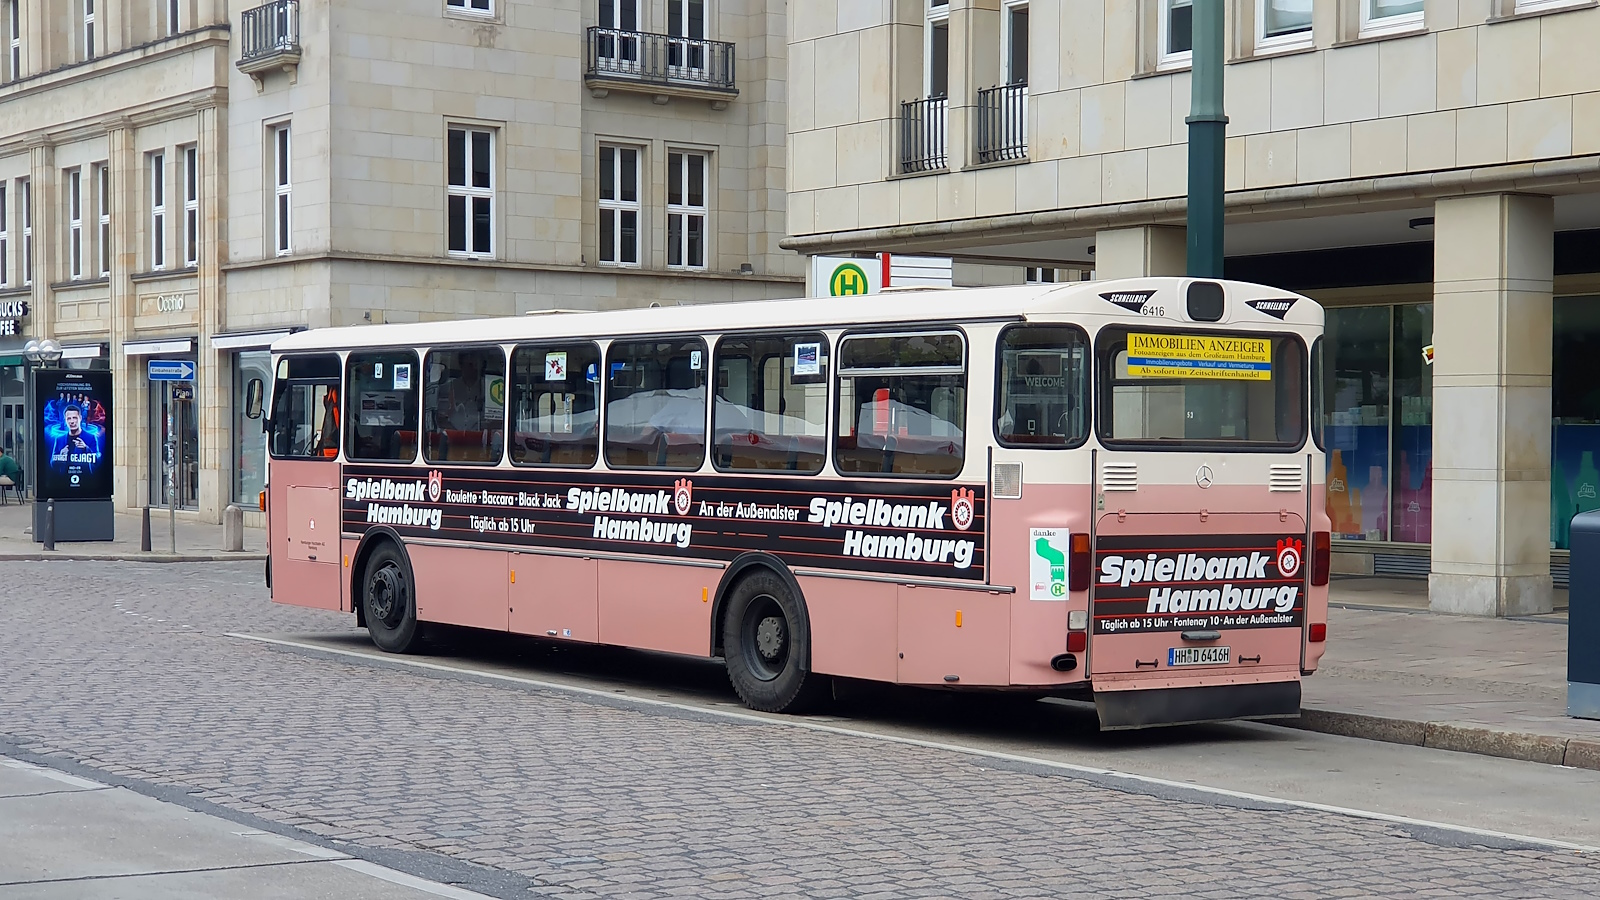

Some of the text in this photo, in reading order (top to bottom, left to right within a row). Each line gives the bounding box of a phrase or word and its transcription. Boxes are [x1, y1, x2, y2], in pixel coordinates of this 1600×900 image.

[841, 274, 858, 296] H
[157, 294, 184, 312] Occhio
[1110, 294, 1147, 303] SCHNELLBUS
[1255, 301, 1290, 311] SCHNELLBUS
[1142, 305, 1165, 317] 6416
[1133, 336, 1266, 353] IMMOBILIEN ANZEIGER
[1133, 348, 1174, 358] Fotoanzeigen
[1203, 352, 1235, 360] Großraum
[1236, 353, 1266, 362] Hamburg
[1145, 358, 1193, 367] Immobilienangebote
[1198, 360, 1216, 368] Verkauf
[1228, 362, 1255, 370] Vermietung
[1140, 366, 1152, 374] Ab
[1153, 367, 1175, 375] sofort
[1189, 369, 1260, 378] Zeitschriftenhandel
[1024, 376, 1065, 388] WELCOME
[70, 453, 97, 464] GEJAGT
[346, 478, 427, 501] Spielbank
[446, 489, 561, 508] Roulette Baccara Black Jack
[565, 486, 672, 514] Spielbank
[366, 503, 443, 530] Hamburg
[699, 501, 799, 521] An der Außenalster
[807, 497, 948, 529] Spielbank
[470, 515, 536, 533] Täglich ab 15 Uhr
[592, 515, 692, 548] Hamburg
[842, 530, 975, 569] Hamburg
[1099, 552, 1271, 588] Spielbank
[1054, 585, 1062, 594] H
[1146, 584, 1299, 613] Hamburg
[1101, 614, 1294, 631] Täglich ab 15 Uhr Fontenay 10 An der Außenalster
[1174, 648, 1230, 663] HH D 6416H
